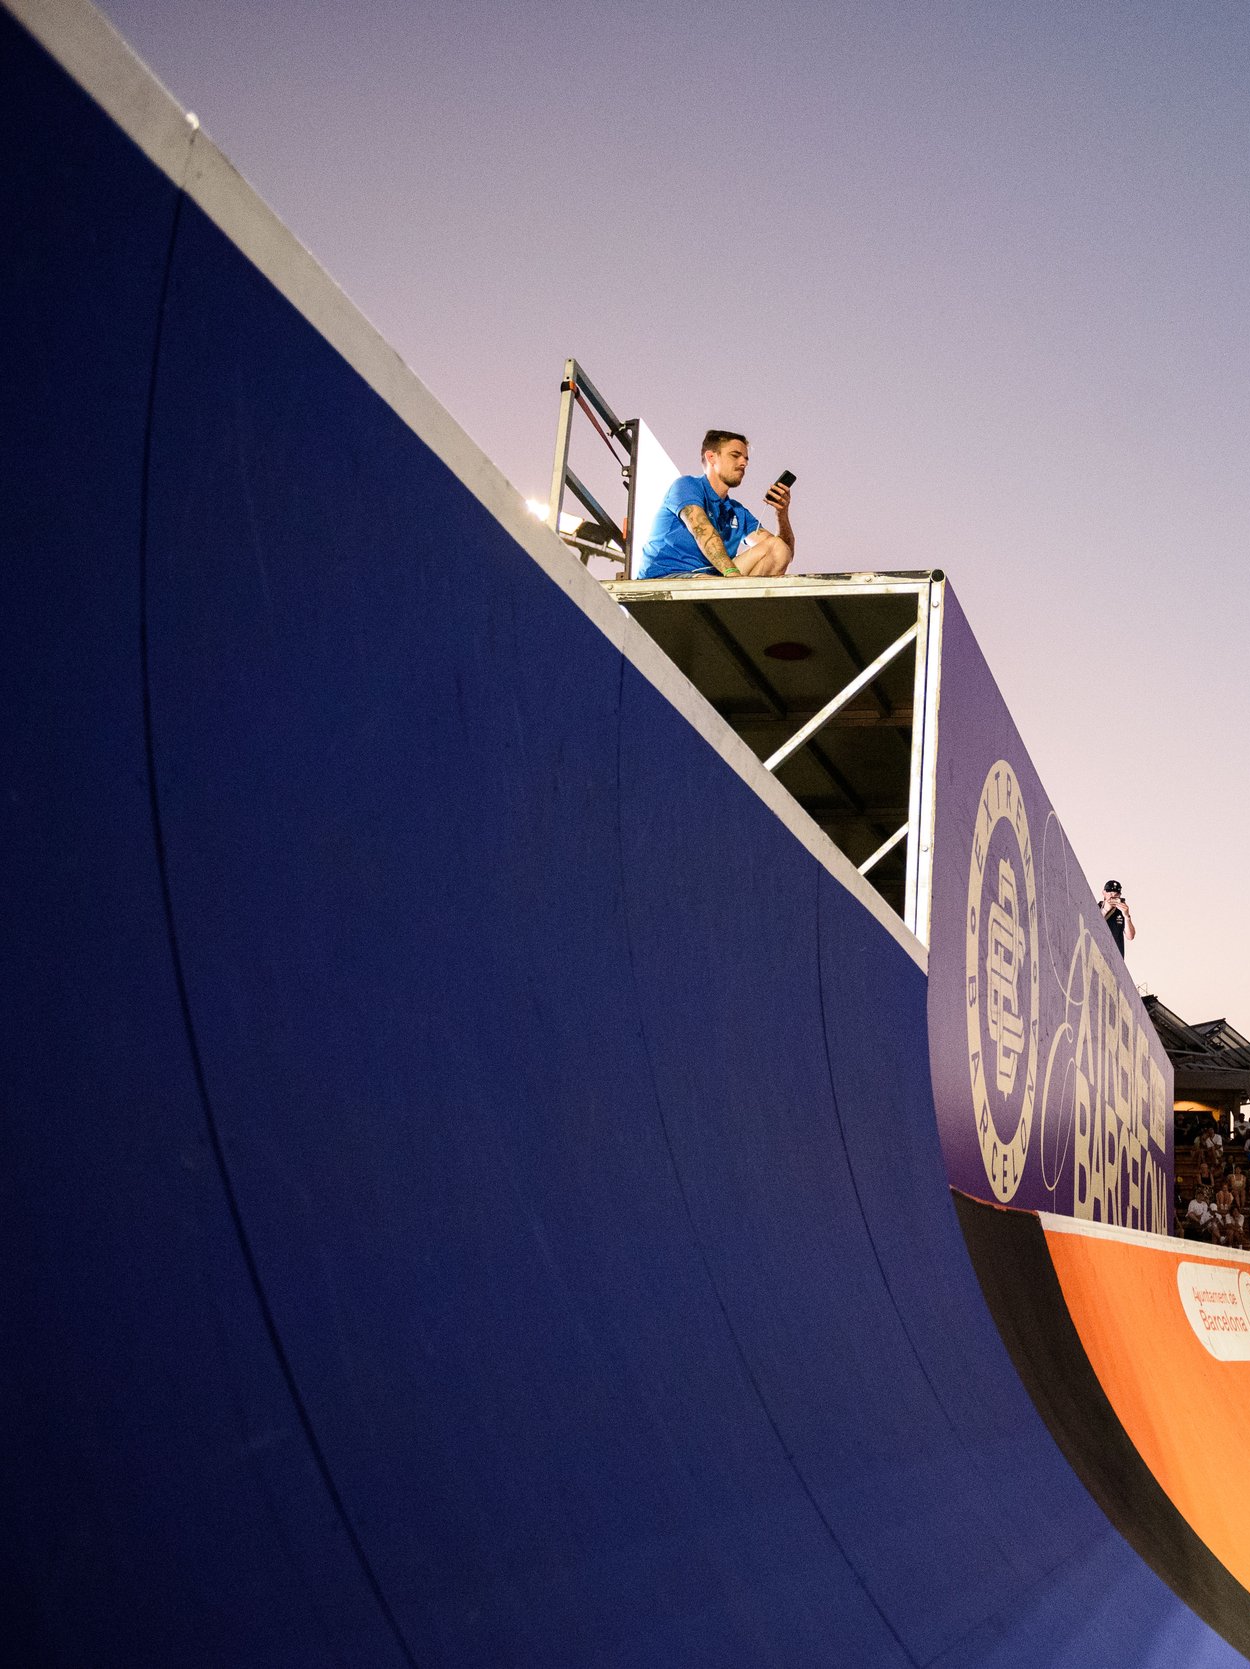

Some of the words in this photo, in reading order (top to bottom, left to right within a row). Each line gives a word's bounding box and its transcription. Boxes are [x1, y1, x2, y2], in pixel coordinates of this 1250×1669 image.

[974, 771, 1037, 929] EXTREME
[968, 974, 1039, 1194] BARCELONA
[1075, 1067, 1168, 1235] BARCELONA
[1199, 1309, 1248, 1331] Barcelona
